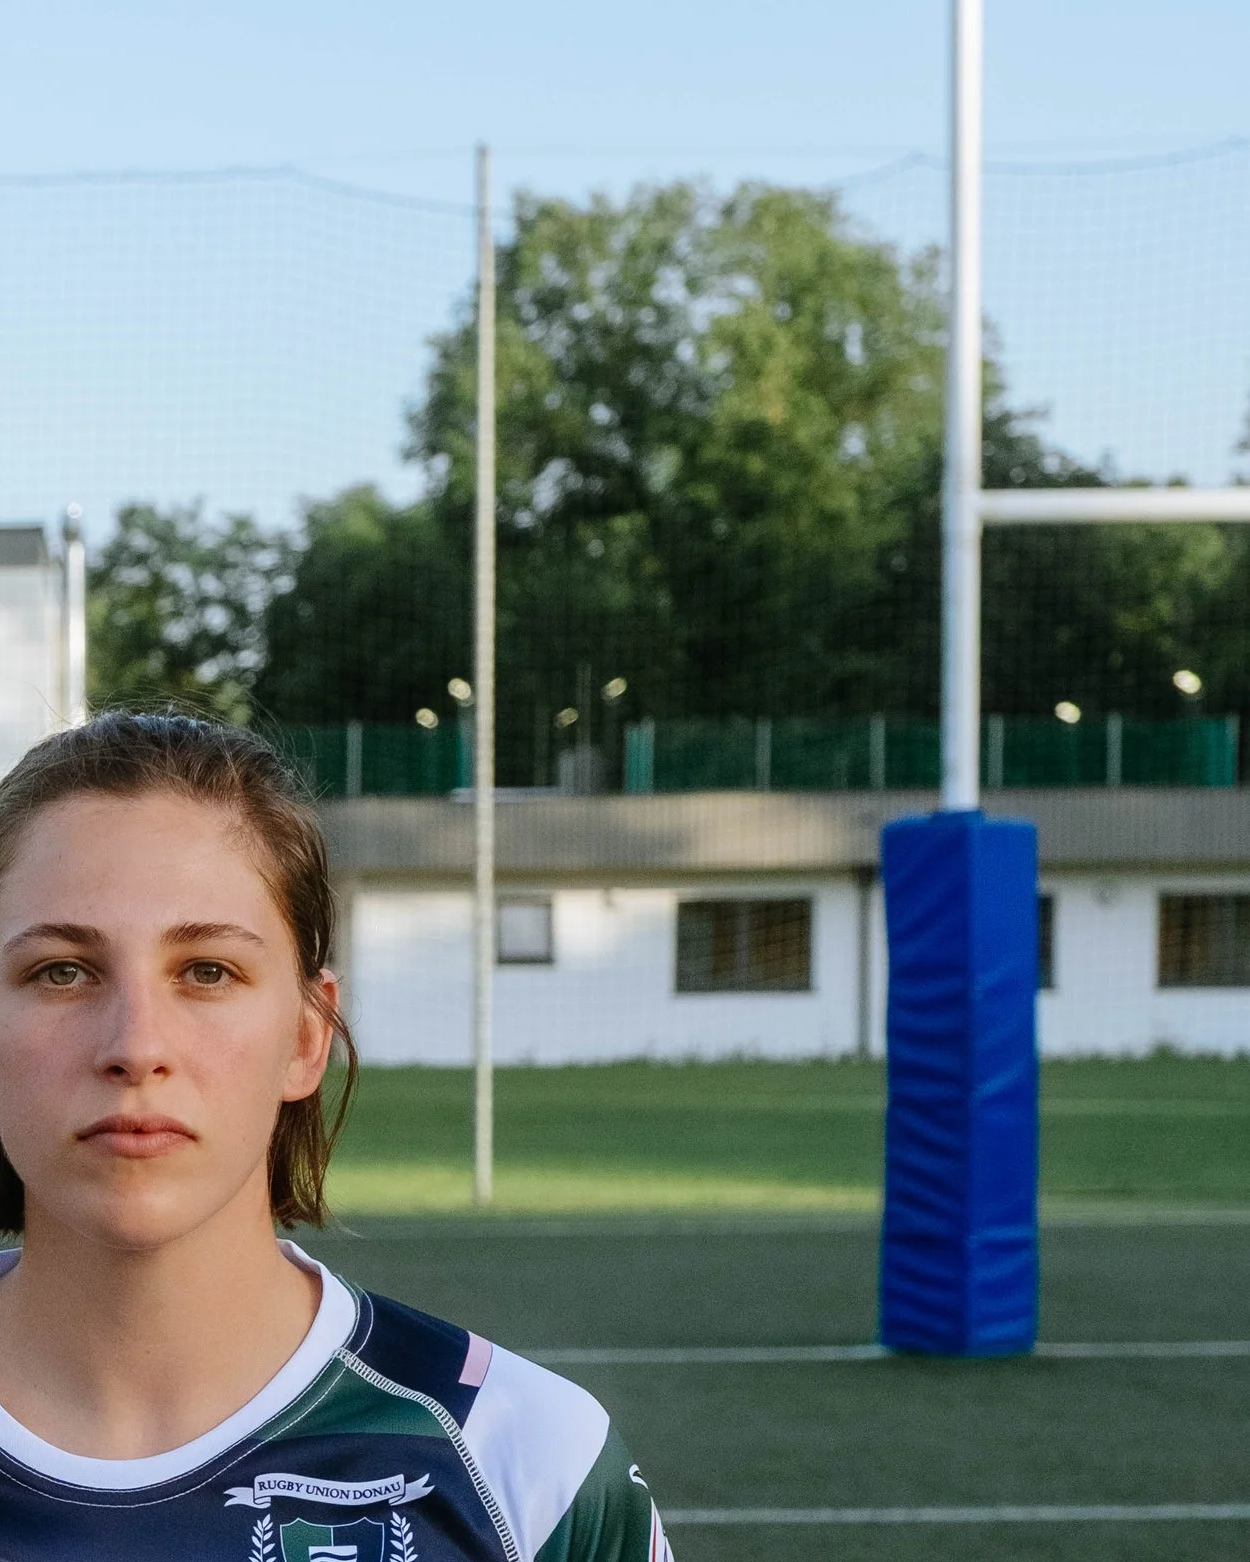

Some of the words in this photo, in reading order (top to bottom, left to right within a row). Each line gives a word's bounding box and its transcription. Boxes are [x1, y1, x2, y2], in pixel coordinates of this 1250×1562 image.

[257, 1480, 304, 1493] RUGBY
[306, 1485, 350, 1499] UNION
[353, 1482, 401, 1499] DONAU
